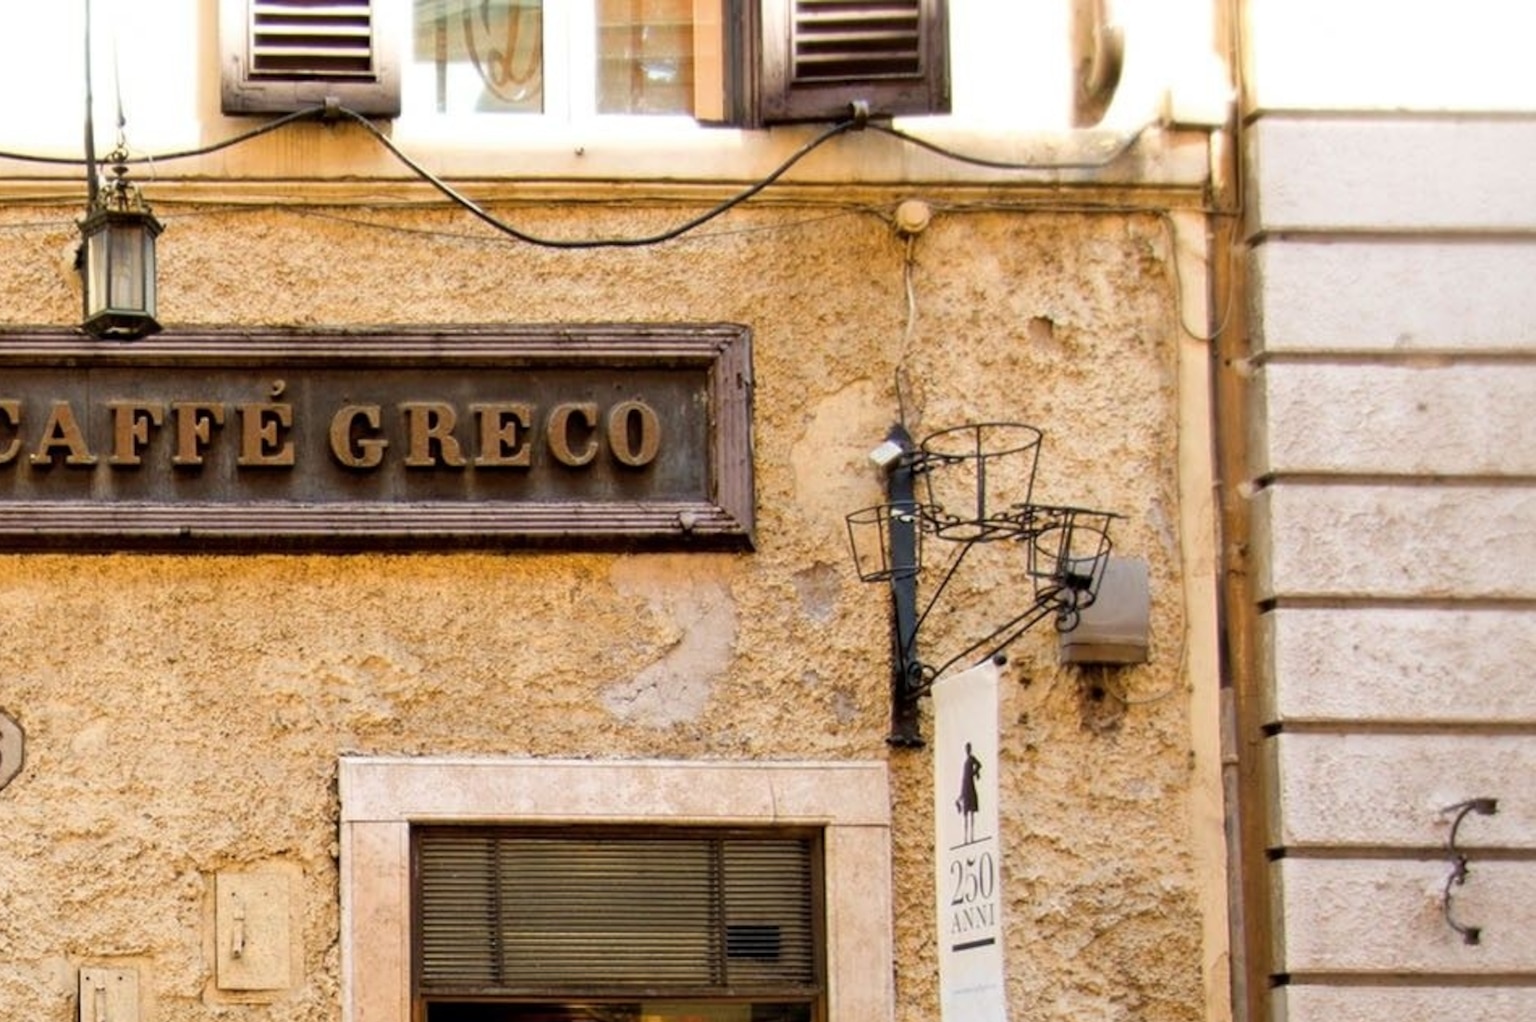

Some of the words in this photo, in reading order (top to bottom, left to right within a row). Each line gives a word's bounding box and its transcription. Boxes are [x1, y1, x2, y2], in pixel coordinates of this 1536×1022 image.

[329, 400, 662, 467] GRECO
[950, 851, 995, 907] 250
[950, 903, 996, 935] ANNI
